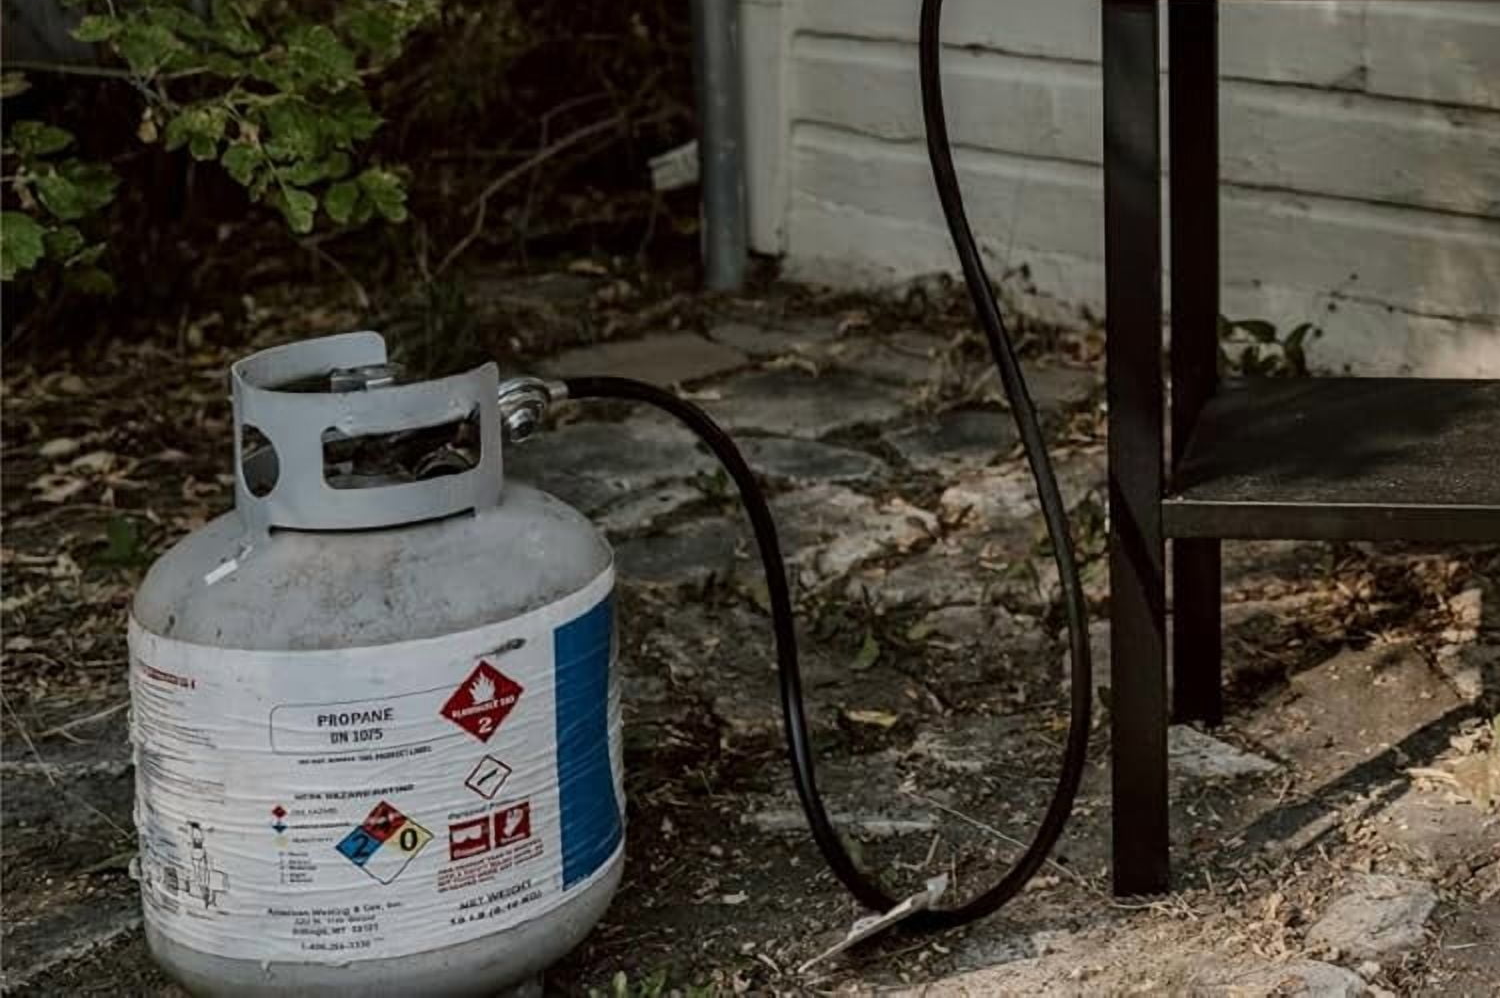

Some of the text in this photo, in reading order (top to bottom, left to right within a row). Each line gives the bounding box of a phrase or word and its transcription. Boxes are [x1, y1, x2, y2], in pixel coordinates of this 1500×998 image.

[317, 708, 394, 727] PROPANE
[478, 717, 493, 733] 2
[352, 728, 383, 742] 1075
[352, 834, 369, 858] 2
[400, 828, 417, 851] 0
